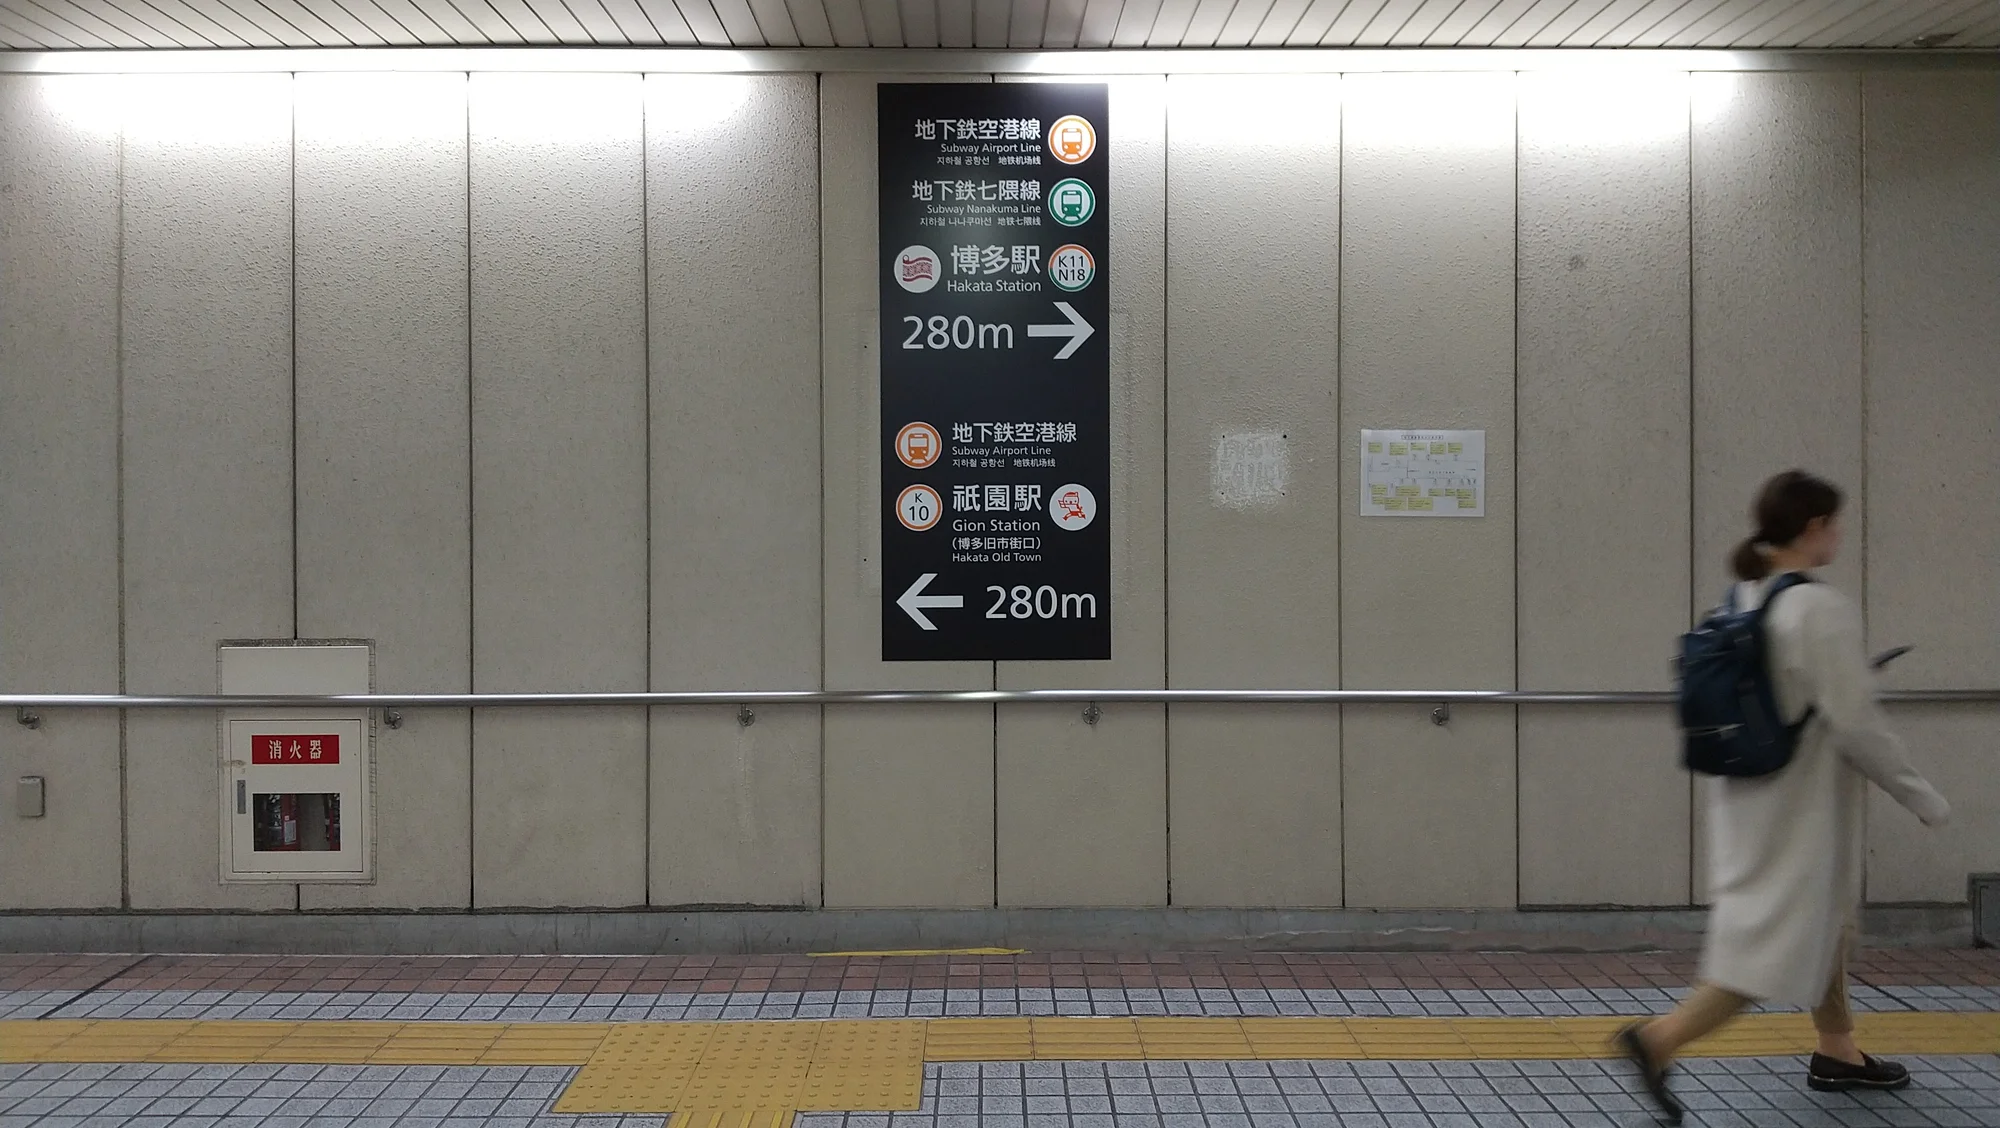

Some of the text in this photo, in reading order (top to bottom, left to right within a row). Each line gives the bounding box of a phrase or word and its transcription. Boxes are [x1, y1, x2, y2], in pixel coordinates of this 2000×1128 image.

[914, 118, 1041, 140] 地下鉄空港線
[941, 143, 1042, 154] Subway Airport Line
[937, 156, 990, 166] 지하철 공항선
[998, 156, 1042, 166] 地铁机场线
[912, 179, 1041, 201] 地下鉄七隈線
[927, 204, 1042, 215] Subway Nanakuma Line
[920, 217, 992, 226] 지하철 나나쿠마선
[950, 244, 1041, 276] 博多駅
[1058, 256, 1084, 268] K11
[1058, 269, 1086, 282] N18
[947, 279, 1041, 292] Hakata Station
[902, 314, 1014, 350] 280m
[952, 421, 1077, 443] 地下鉄空港線
[952, 446, 1051, 457] Subway Airport Line
[952, 458, 1005, 468] 지하철 공항선
[1013, 458, 1056, 467] 地铁机场线
[914, 493, 923, 503] K
[952, 484, 1042, 512] 祇園駅
[908, 506, 930, 521] 10
[952, 519, 1041, 532] Gion Station
[952, 552, 1042, 562] Hakata Old Town
[985, 584, 1097, 620] 280m
[269, 739, 322, 760] 消火器
